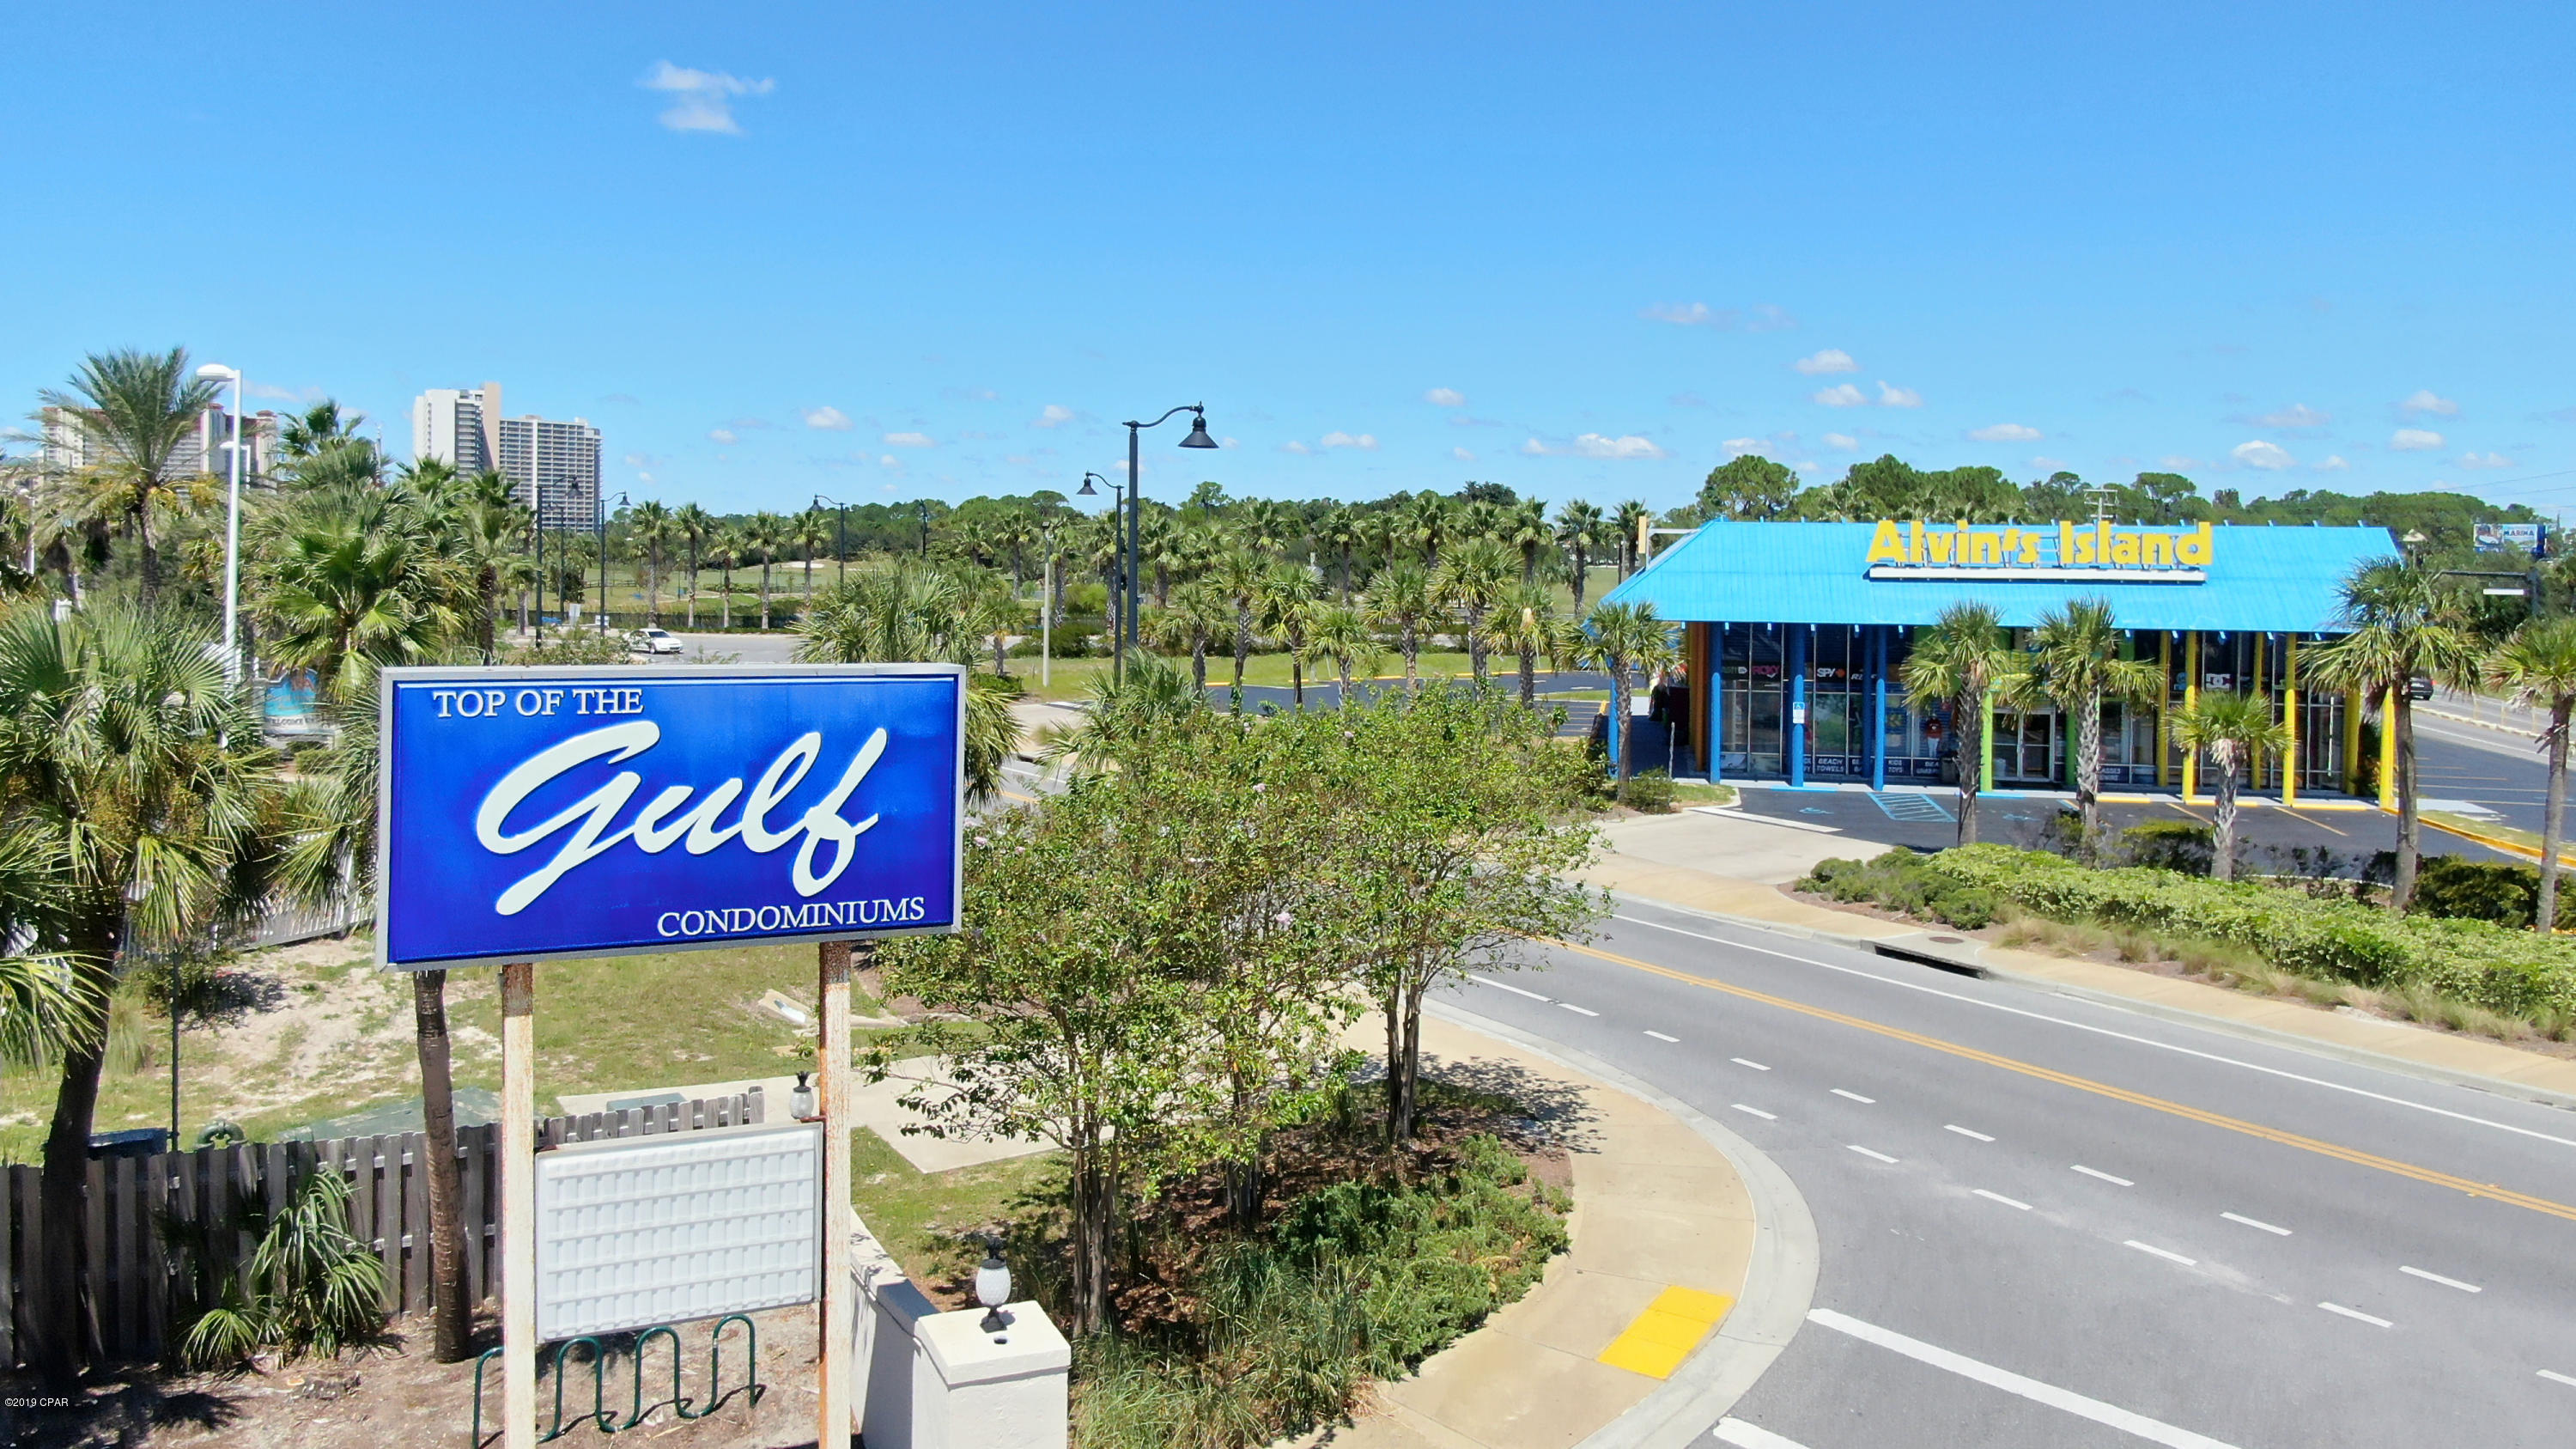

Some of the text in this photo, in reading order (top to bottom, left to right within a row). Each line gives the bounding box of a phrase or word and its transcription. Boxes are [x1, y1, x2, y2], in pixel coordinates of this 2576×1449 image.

[1866, 519, 2213, 566] Alvin's Island
[1753, 666, 1780, 675] ROXY
[1816, 668, 1836, 678] SPY
[433, 688, 644, 718] TOP OF THE
[476, 719, 888, 916] Gulf
[656, 896, 926, 938] CONDOMINIUMS
